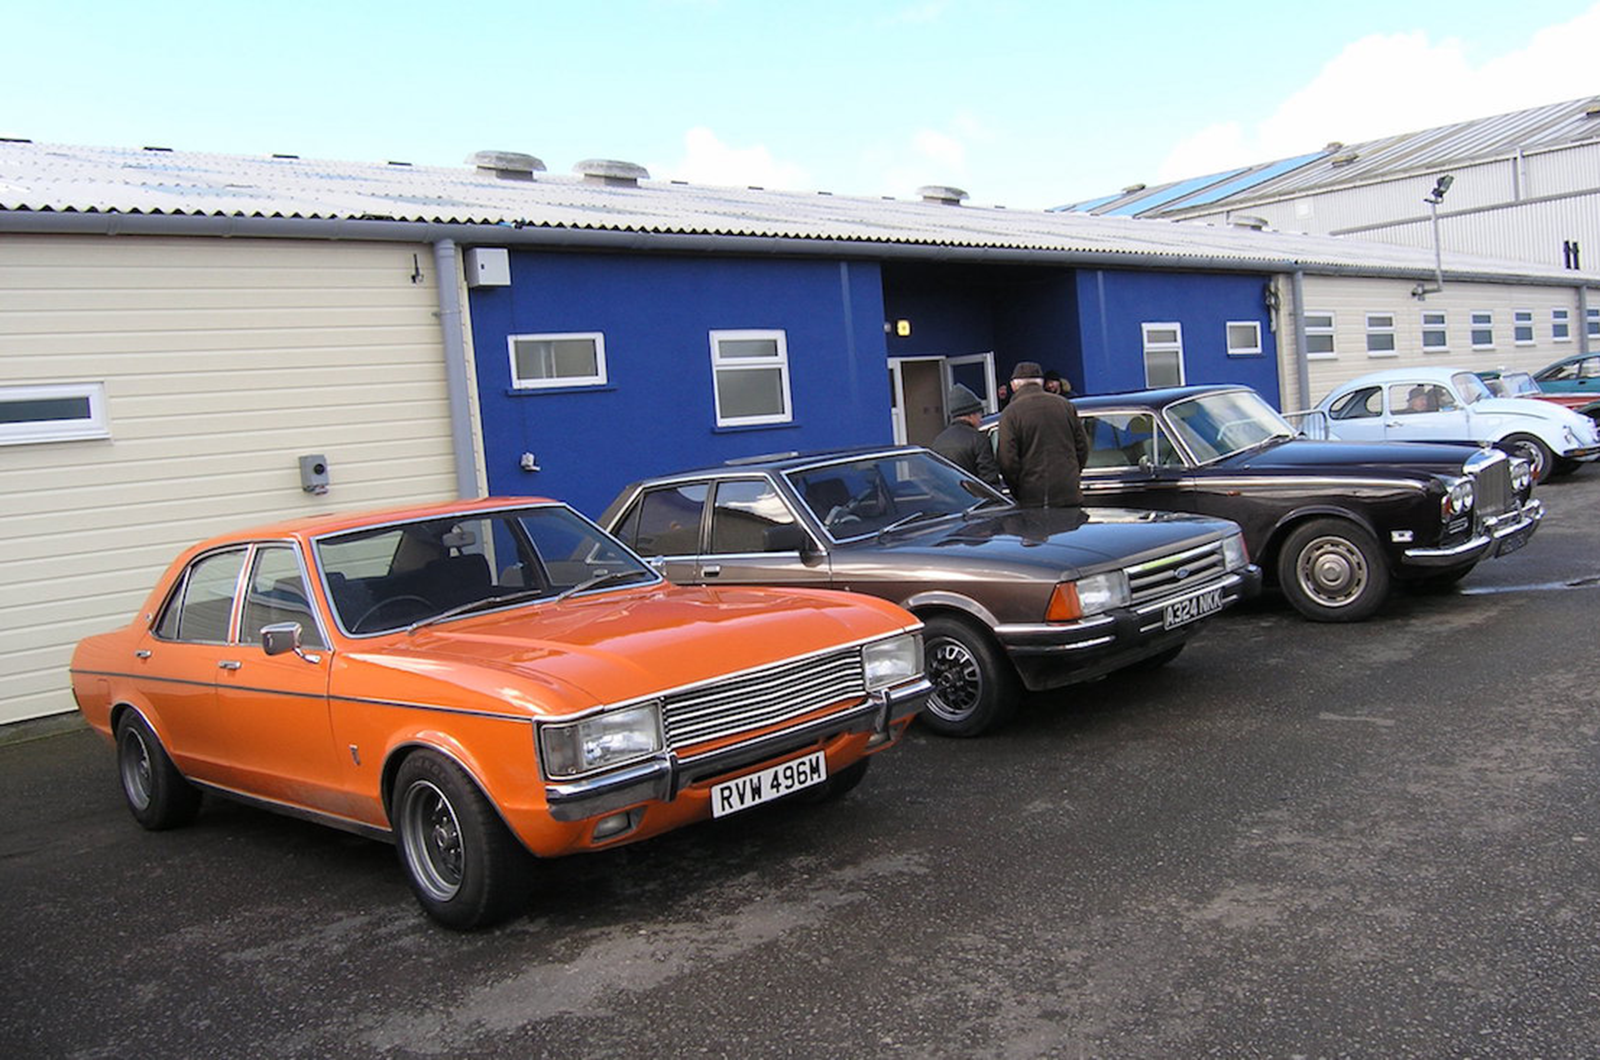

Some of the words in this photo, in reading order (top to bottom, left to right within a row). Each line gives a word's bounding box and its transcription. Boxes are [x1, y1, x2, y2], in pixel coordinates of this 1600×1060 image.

[1166, 597, 1198, 626] A324
[1199, 589, 1222, 613] NKK
[719, 775, 762, 812] RVW
[770, 755, 821, 794] 496M
